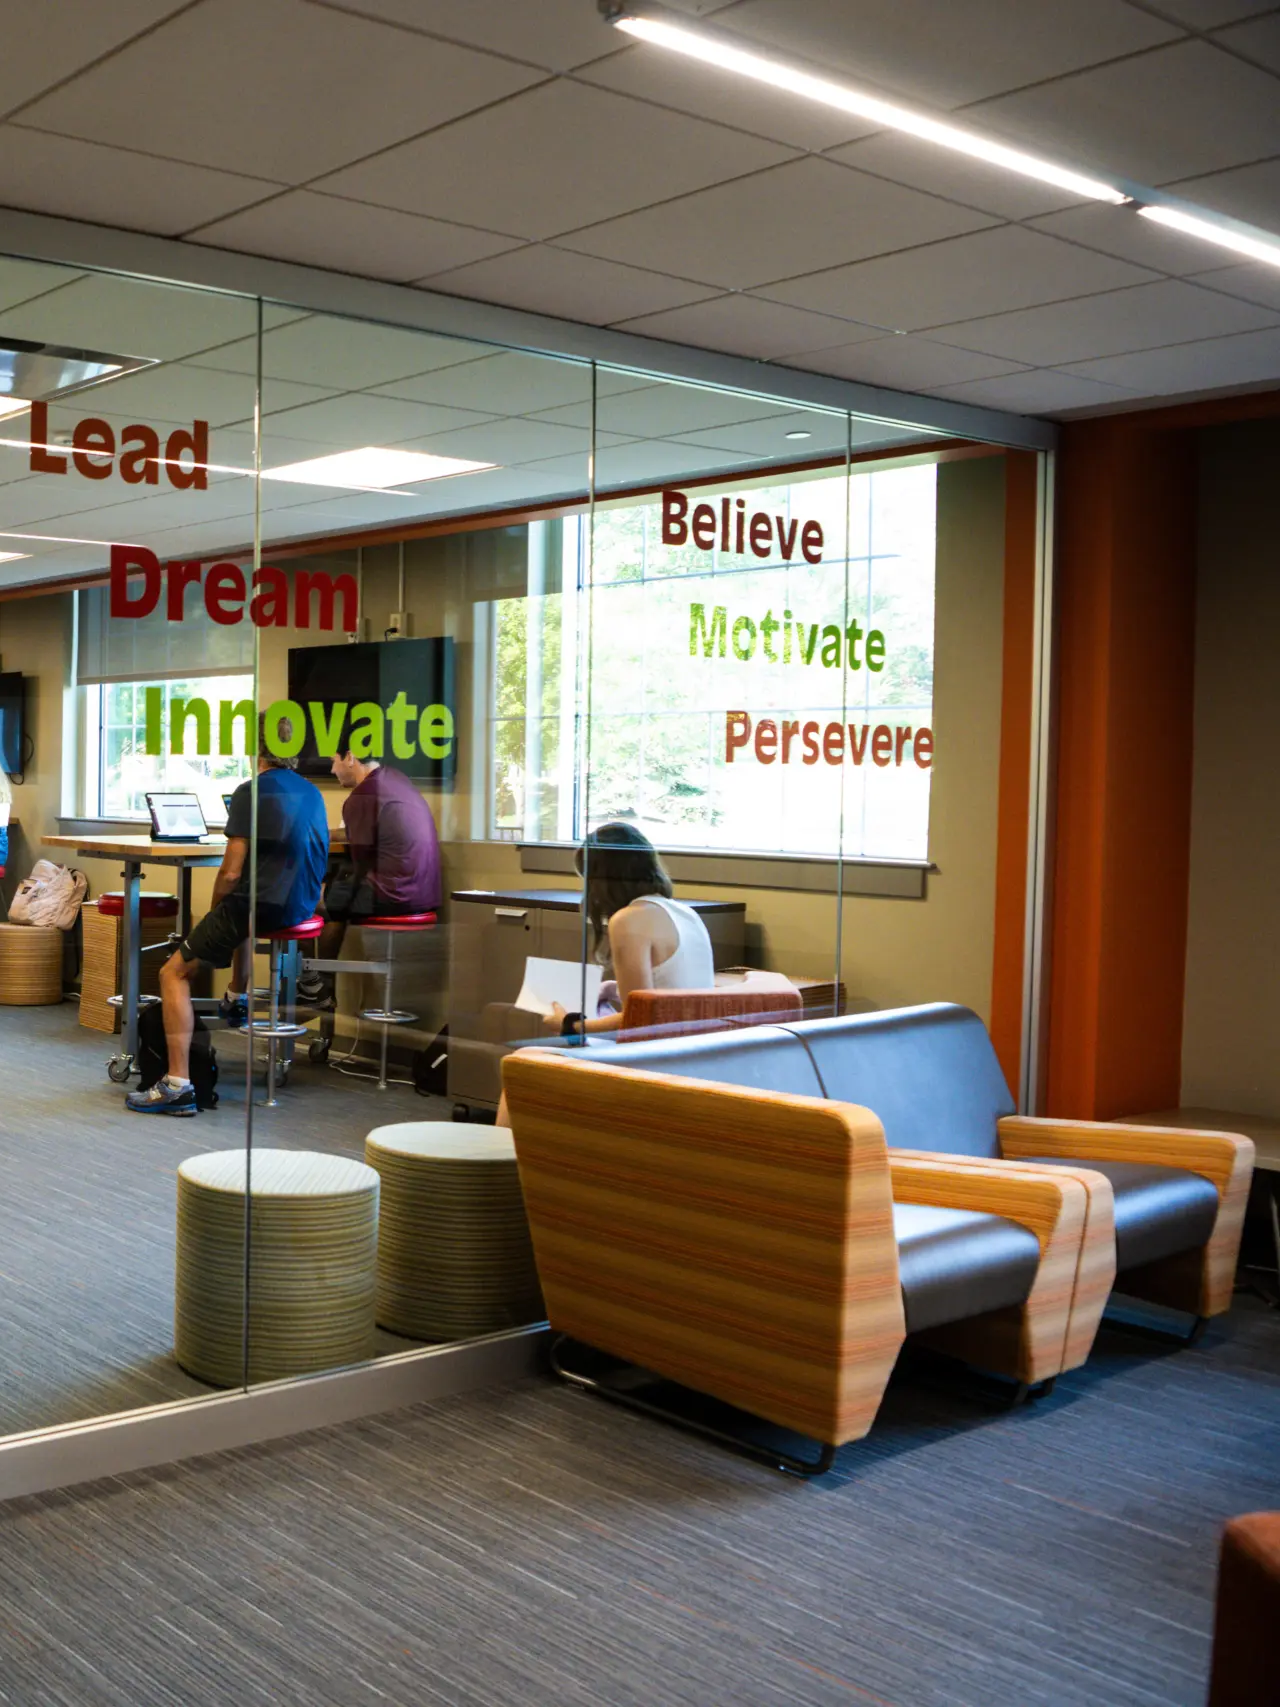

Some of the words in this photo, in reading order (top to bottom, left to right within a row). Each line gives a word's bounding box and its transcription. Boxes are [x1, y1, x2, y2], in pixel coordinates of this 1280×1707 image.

[30, 401, 208, 490] Lead
[661, 490, 824, 564] Believe
[111, 544, 358, 632] Dream
[689, 603, 886, 672] Motivate
[145, 687, 454, 759] Innovate
[725, 711, 935, 769] Persevere
